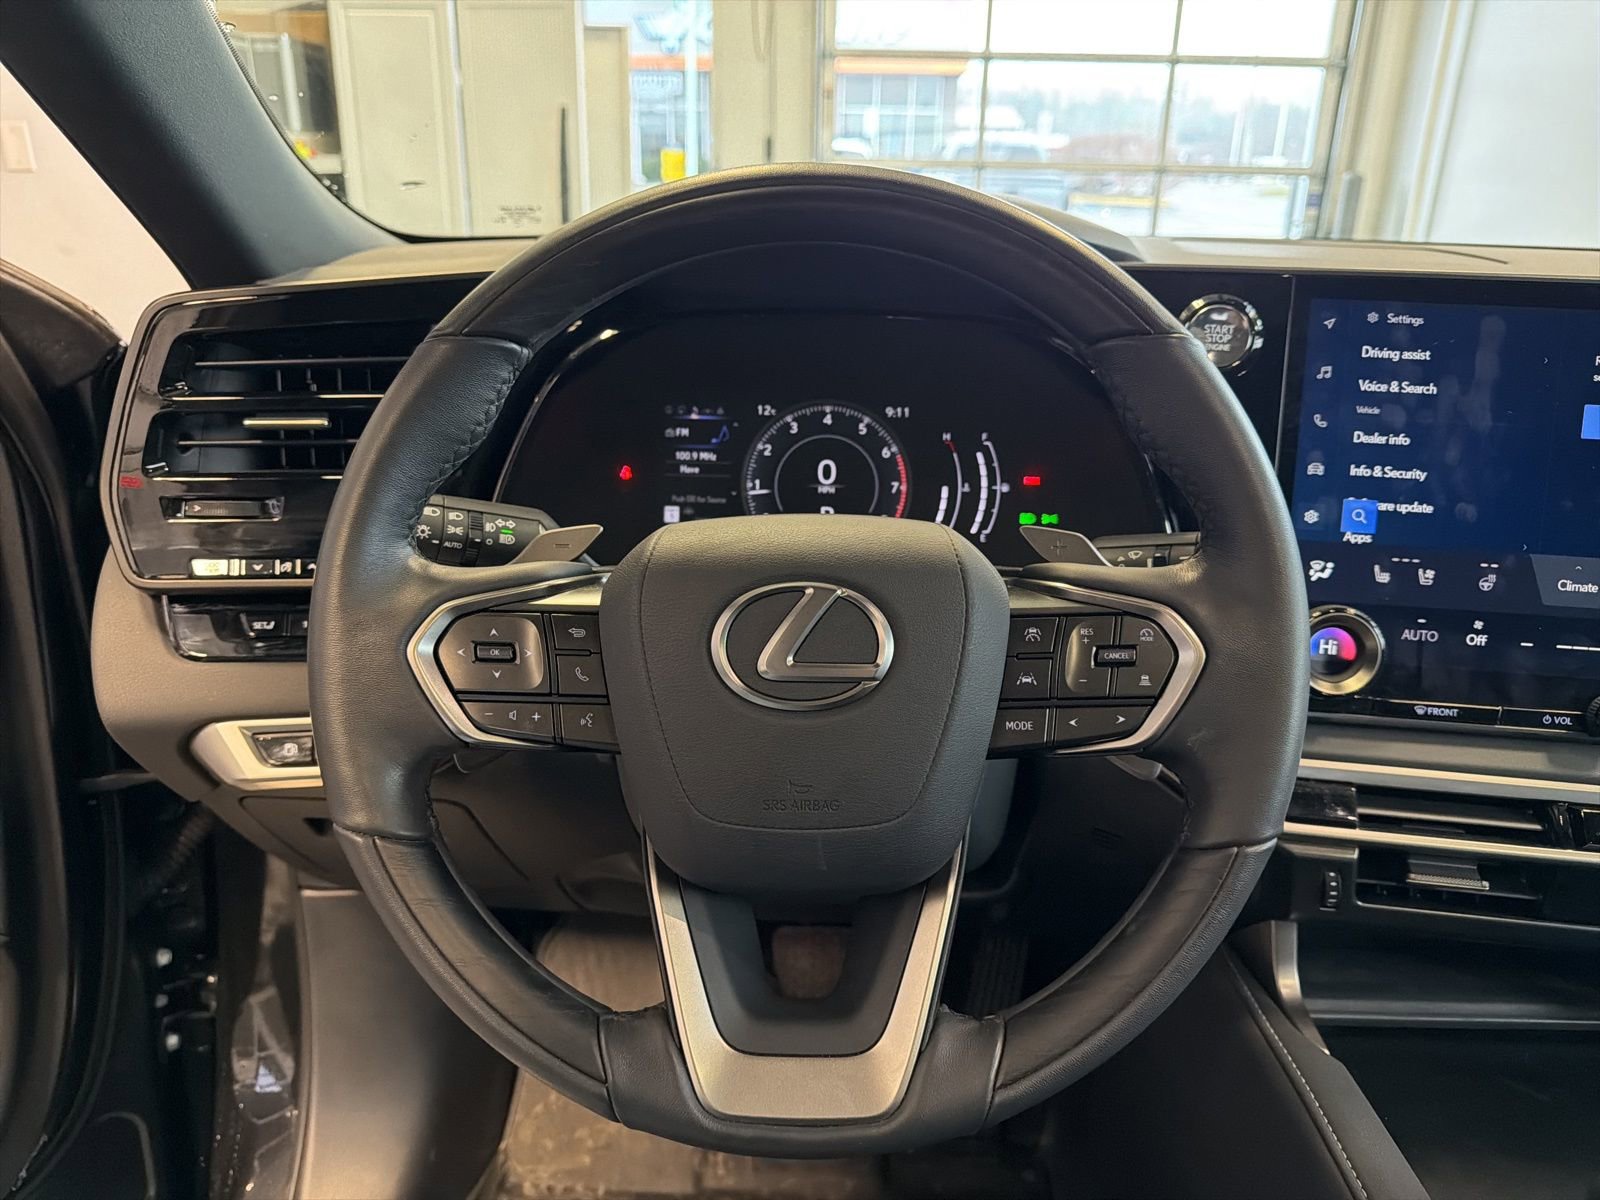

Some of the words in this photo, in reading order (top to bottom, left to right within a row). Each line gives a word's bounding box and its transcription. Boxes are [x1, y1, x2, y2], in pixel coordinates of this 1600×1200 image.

[1386, 313, 1424, 327] Settings
[1203, 324, 1236, 335] START
[1205, 334, 1232, 343] STOP
[1361, 345, 1400, 362] Driving
[1401, 348, 1431, 361] assist
[1358, 379, 1388, 393] Voice
[1390, 381, 1400, 394] &
[1401, 381, 1437, 395] Search
[885, 406, 910, 418] 9:11
[1356, 404, 1381, 416] Vehicle
[822, 413, 833, 425] 4
[789, 421, 799, 434] 3
[858, 422, 868, 435] 5
[1353, 430, 1388, 445] Dealer
[1389, 432, 1411, 446] info
[763, 443, 772, 456] 2
[881, 446, 891, 459] 6
[817, 458, 837, 485] 0
[1350, 464, 1371, 478] Info
[1372, 465, 1383, 478] &
[1383, 466, 1428, 482] Security
[754, 479, 761, 490] 1
[891, 481, 900, 494] 7
[1396, 501, 1434, 515] update
[1343, 531, 1373, 544] Apps
[443, 541, 463, 550] AUTO
[1557, 579, 1599, 594] Climate
[1080, 627, 1094, 636] RES
[1401, 629, 1439, 643] AUTO
[1318, 639, 1338, 655] Hi
[1466, 634, 1488, 647] Off
[489, 648, 500, 656] OK
[1104, 651, 1129, 660] CANCEL
[1427, 707, 1459, 718] FRONT
[1005, 720, 1034, 731] MODE
[1554, 715, 1573, 726] VOL
[762, 799, 786, 811] SRS
[790, 799, 840, 812] AIRBAG
